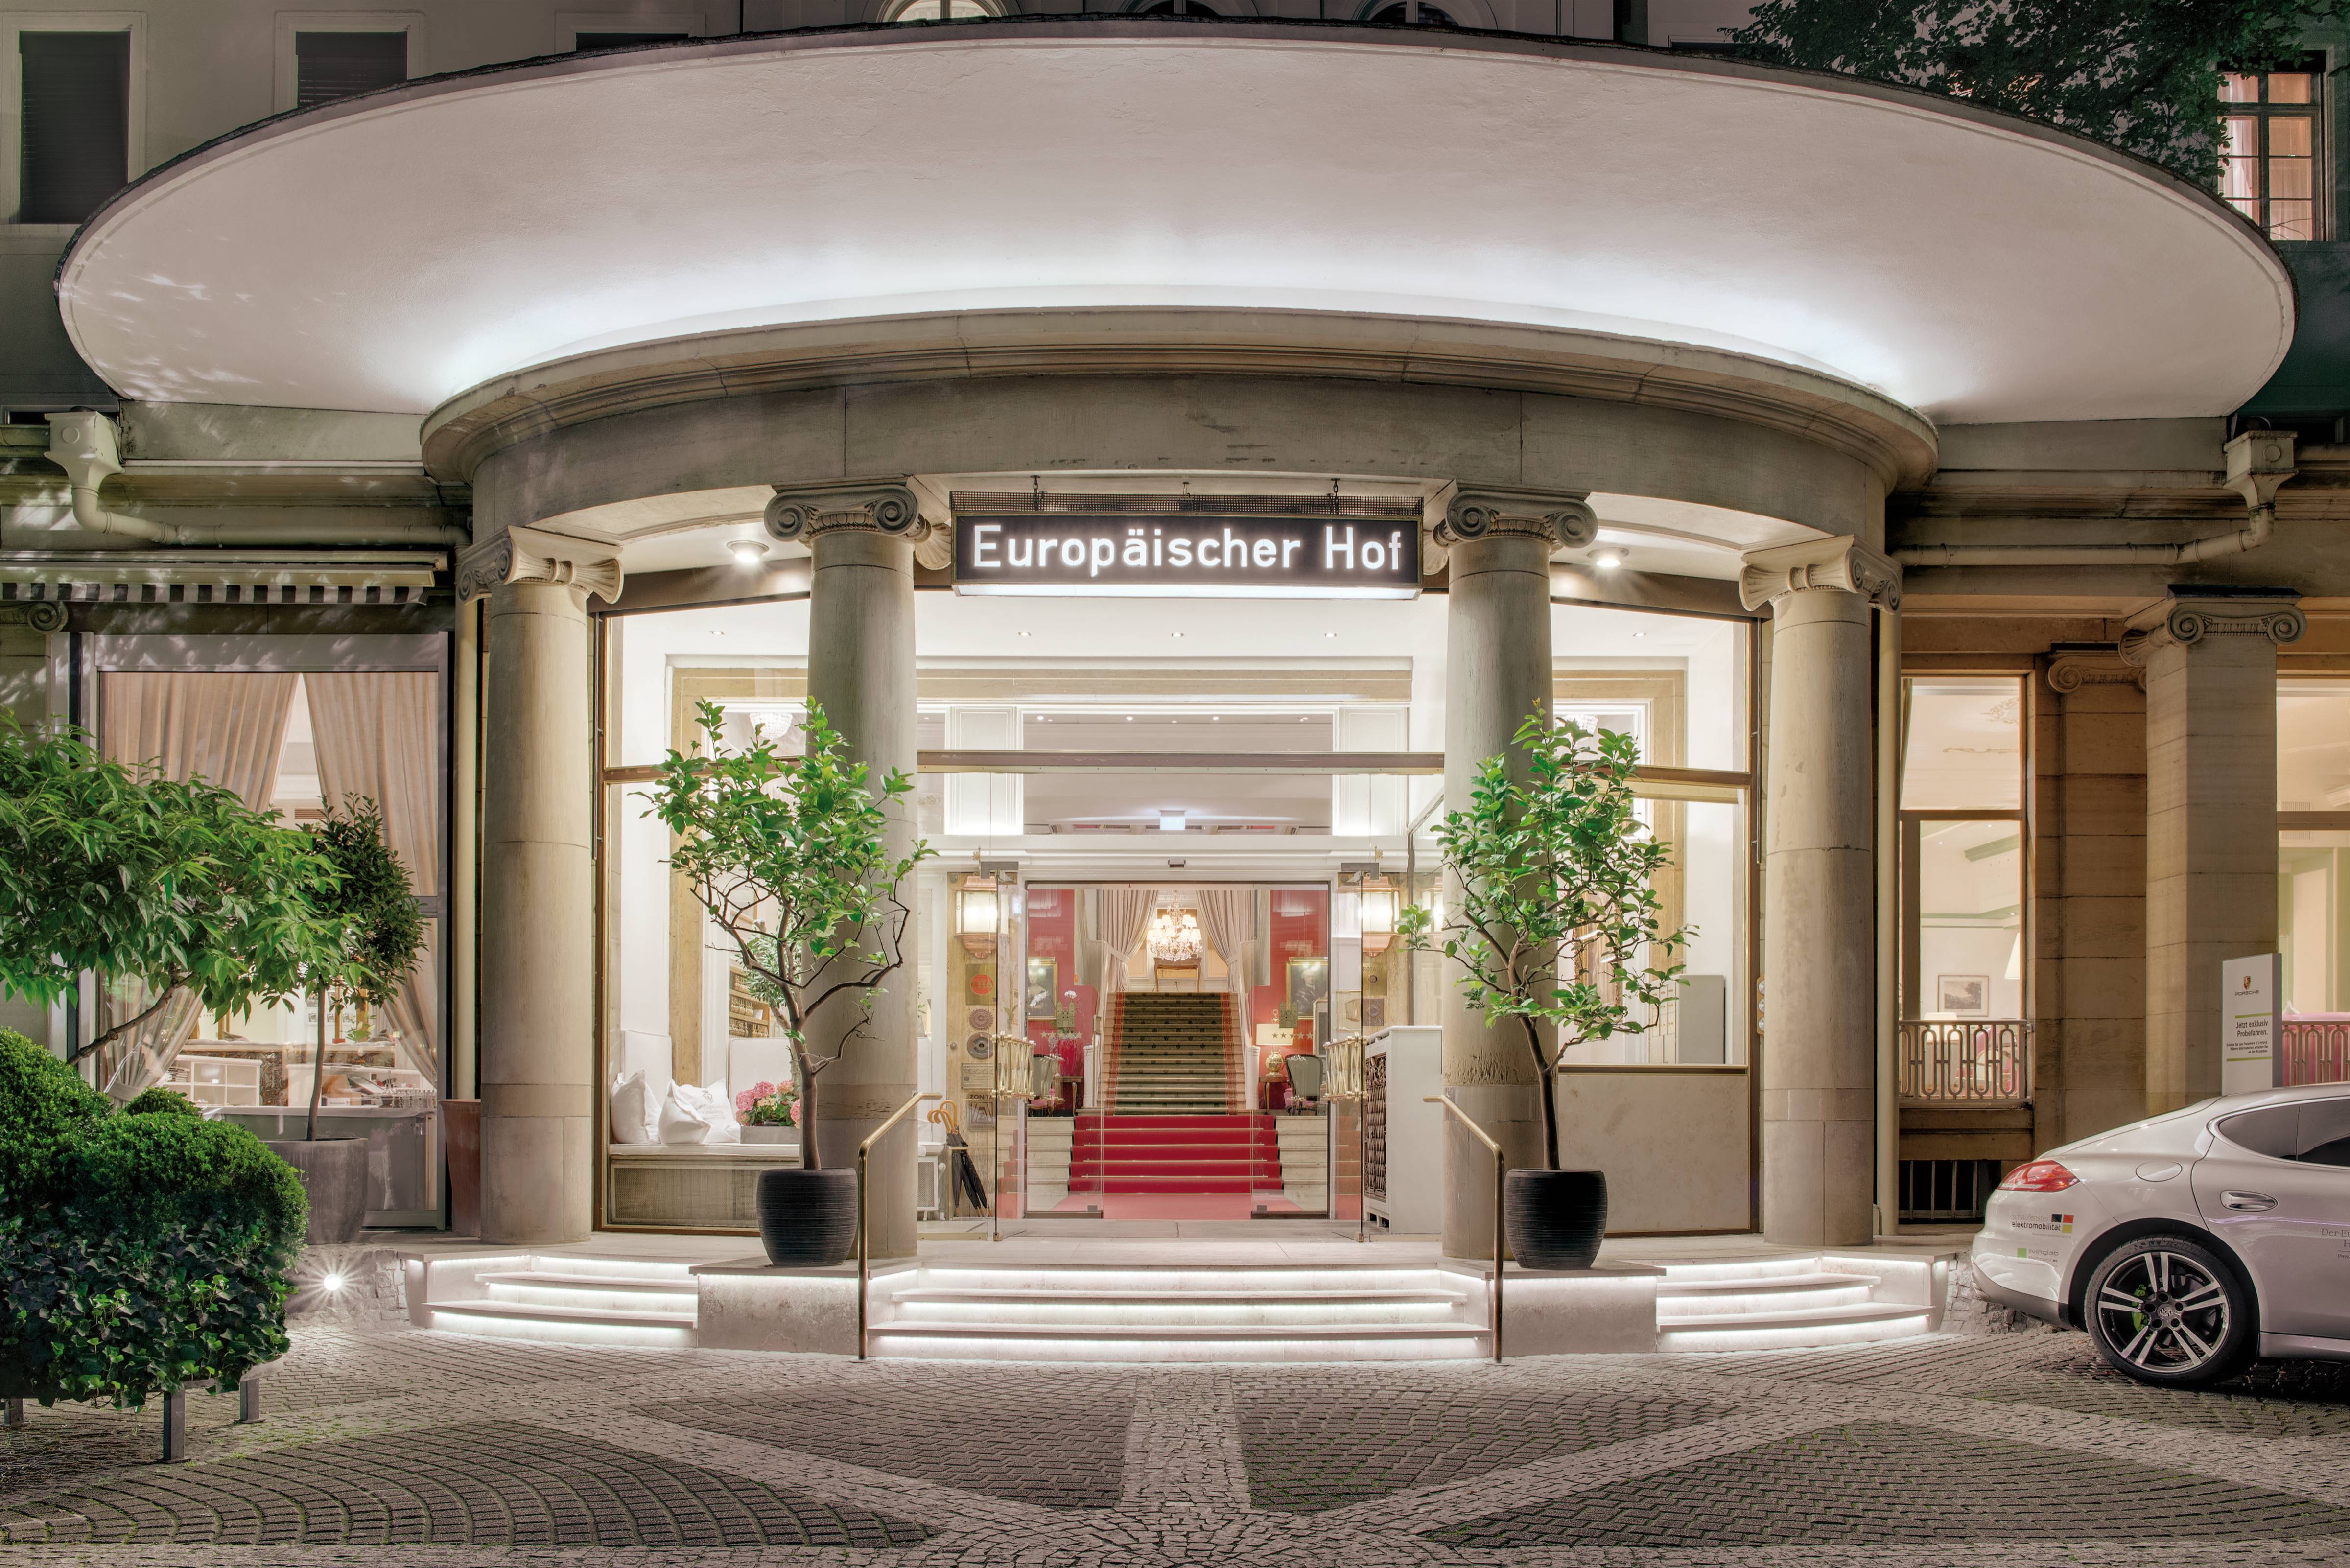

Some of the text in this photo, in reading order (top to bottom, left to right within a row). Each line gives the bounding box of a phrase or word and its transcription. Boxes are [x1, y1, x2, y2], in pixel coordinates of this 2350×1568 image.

[973, 524, 1402, 577] Europäischer Hof
[2012, 1214, 2049, 1222] schaufenster
[2322, 1228, 2338, 1236] Der
